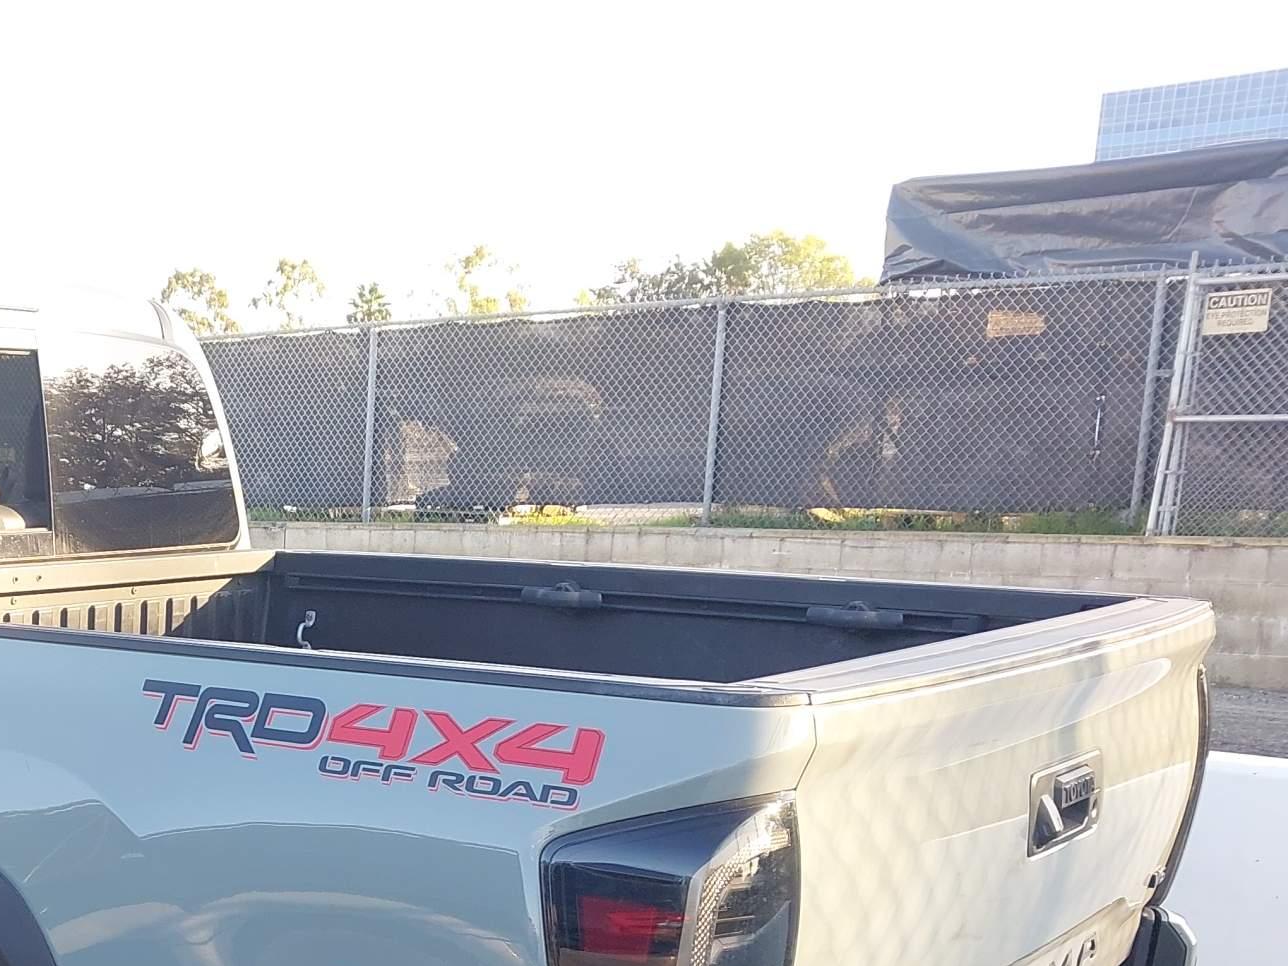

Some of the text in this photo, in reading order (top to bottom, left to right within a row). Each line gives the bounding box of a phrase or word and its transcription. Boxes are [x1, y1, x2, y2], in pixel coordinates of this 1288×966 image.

[1210, 293, 1267, 309] CAUTION
[318, 754, 580, 811] OFF ROAD
